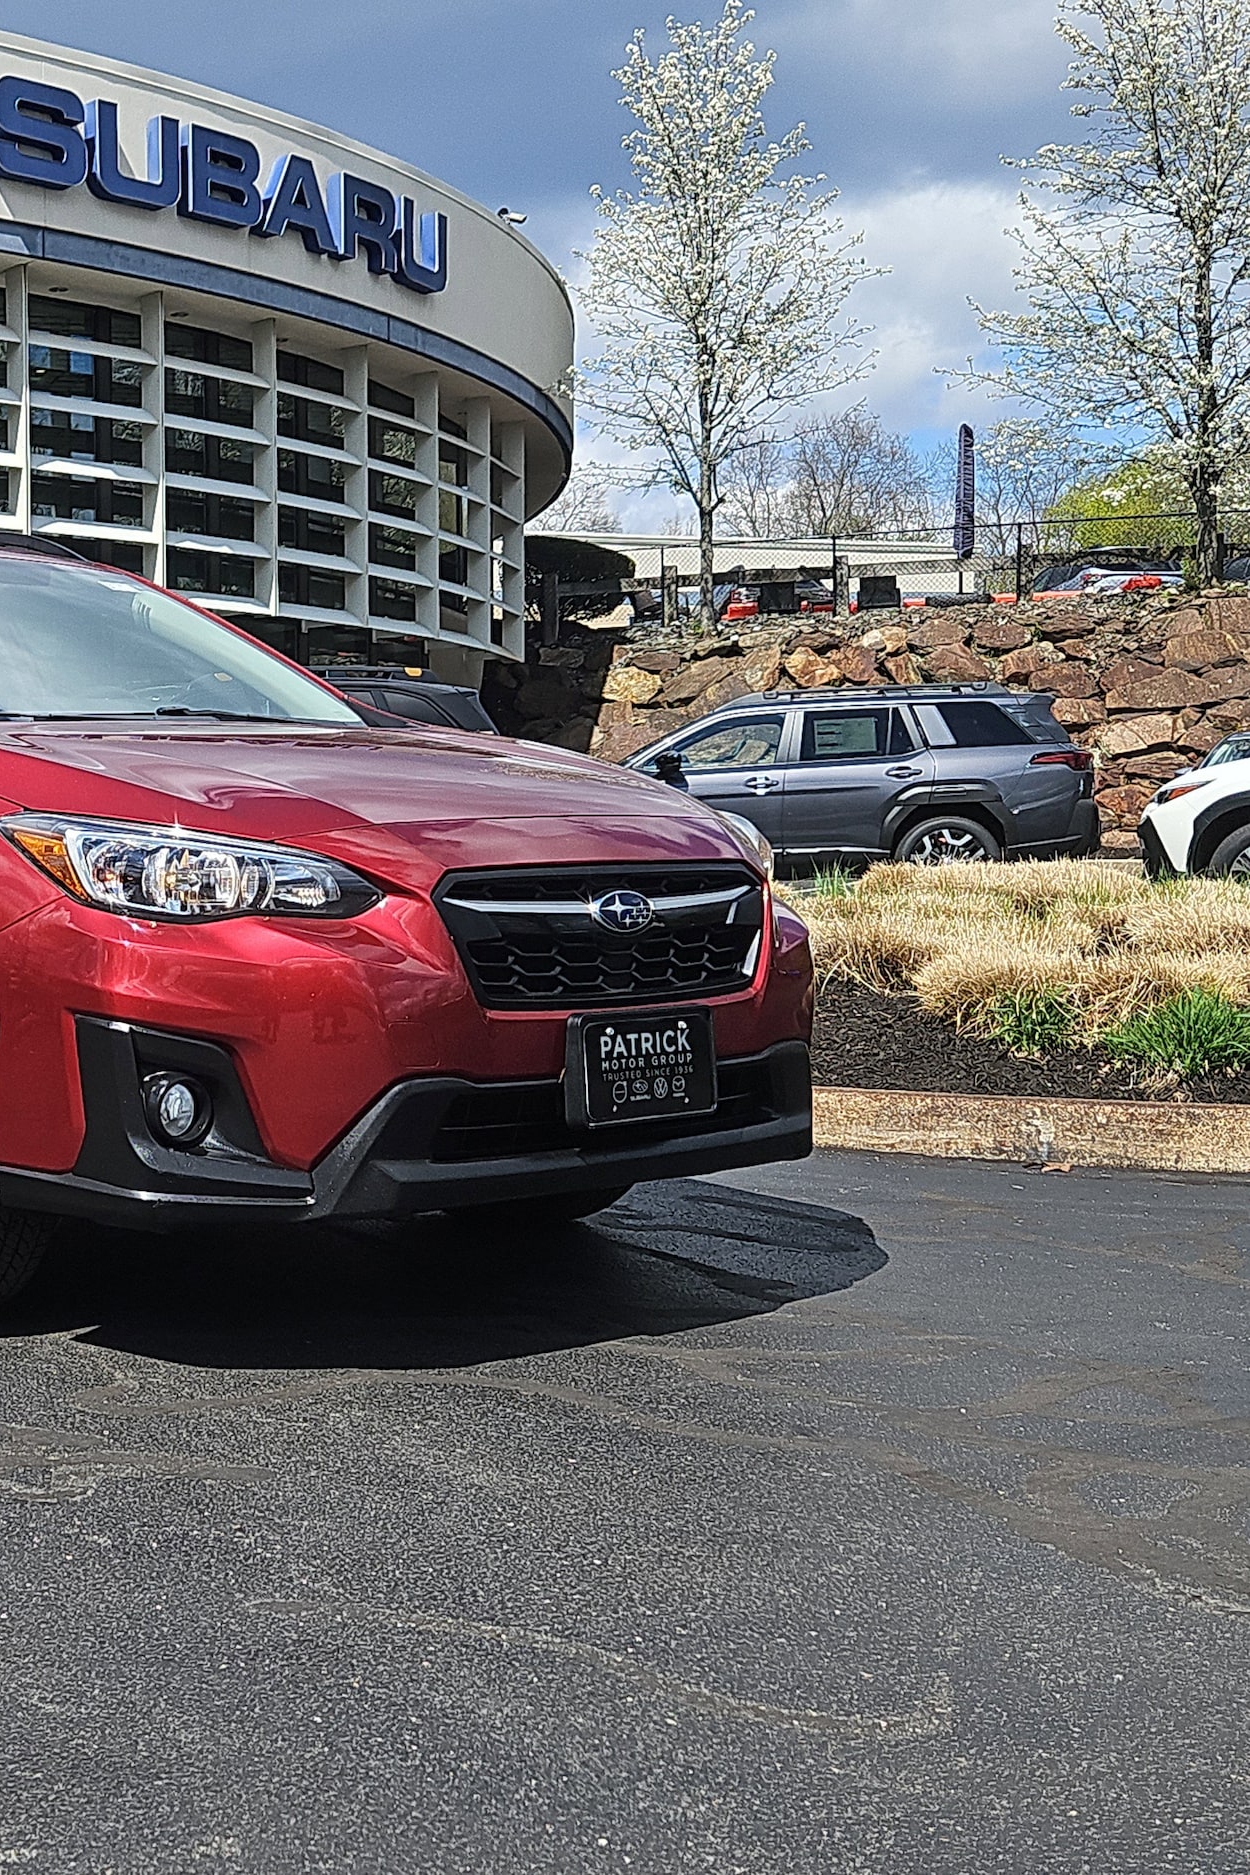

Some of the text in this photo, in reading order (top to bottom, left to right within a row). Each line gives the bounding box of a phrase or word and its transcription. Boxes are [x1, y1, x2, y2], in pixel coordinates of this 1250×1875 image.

[600, 1028, 692, 1059] PATRICK
[602, 1052, 693, 1071] MOTOR GROUP
[602, 1070, 642, 1081] TRUSTED
[645, 1066, 671, 1078] SINCE
